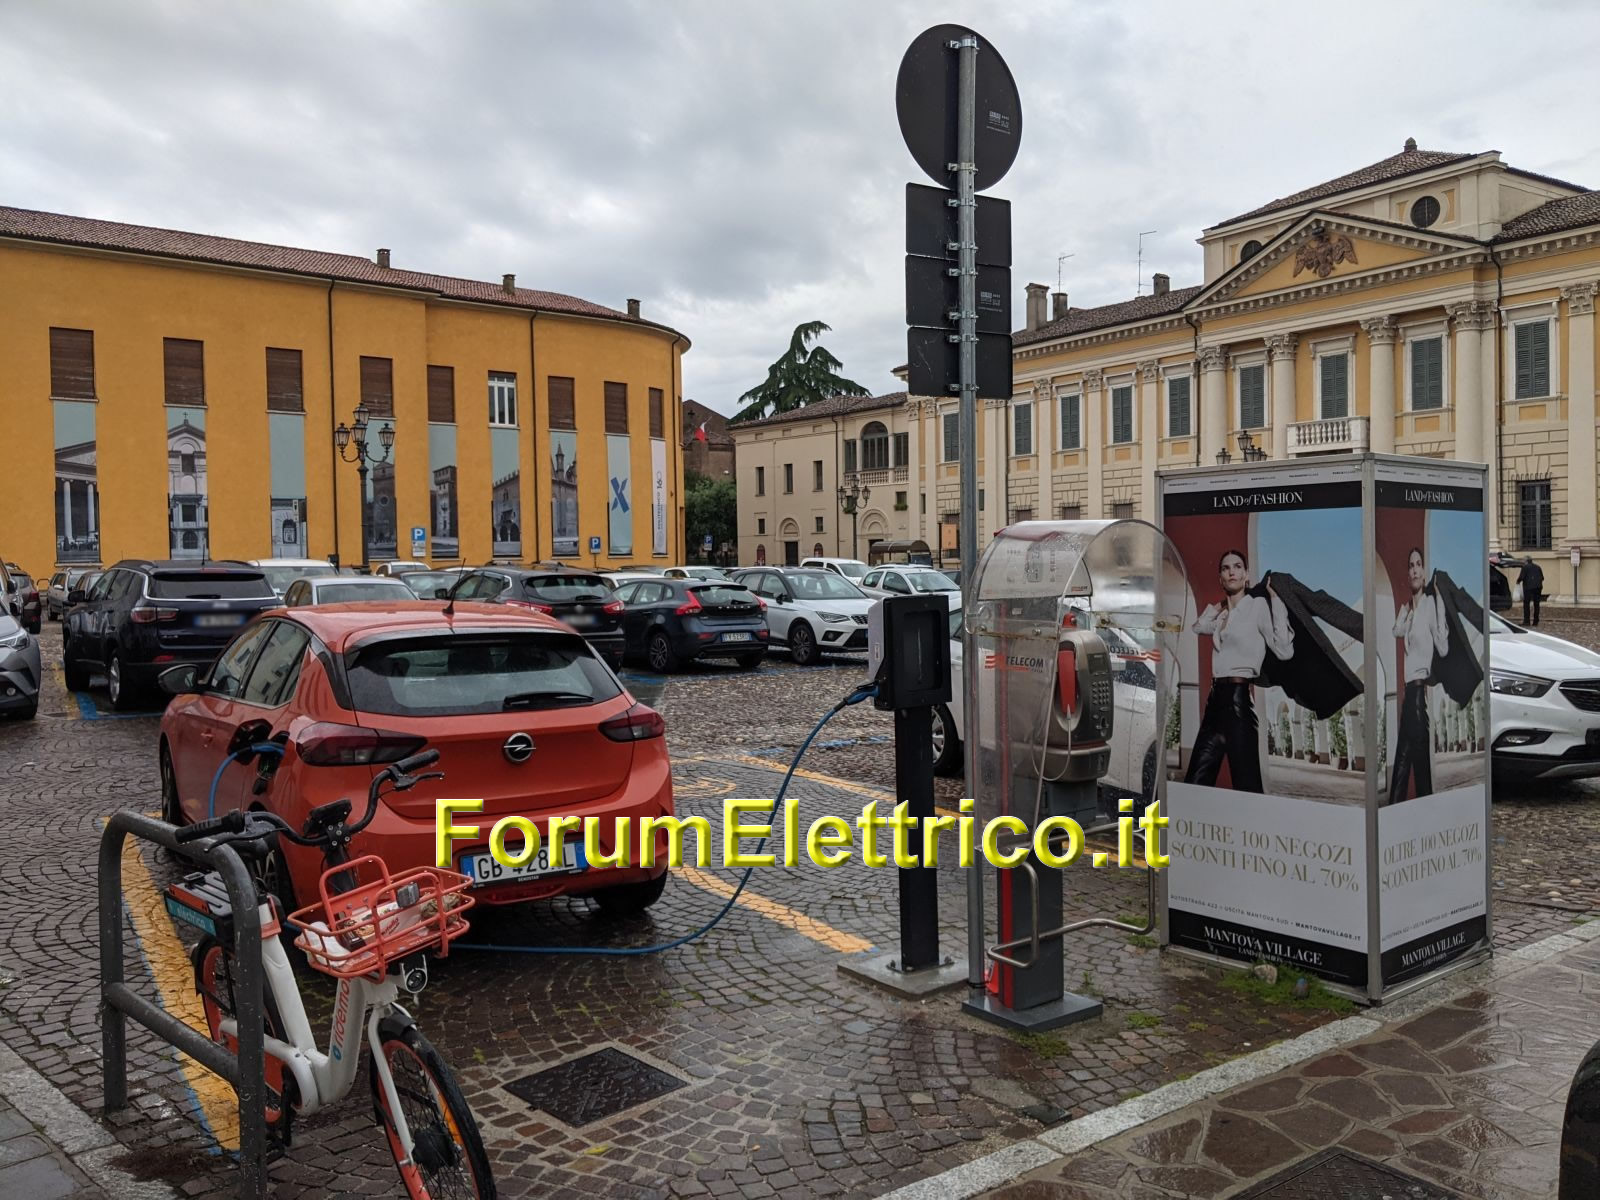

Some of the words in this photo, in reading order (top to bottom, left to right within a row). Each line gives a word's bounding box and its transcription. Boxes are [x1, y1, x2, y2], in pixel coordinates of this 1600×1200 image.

[1214, 495, 1244, 508] LAND
[1244, 494, 1253, 506] of
[1253, 491, 1303, 506] FASHION
[1405, 489, 1423, 502] LAND
[1427, 491, 1454, 503] FASHION
[414, 528, 424, 540] P
[592, 537, 599, 549] P
[1006, 656, 1044, 668] TELECOM
[1175, 818, 1234, 845] OLTRE
[1241, 830, 1270, 850] 100
[1275, 835, 1353, 866] NEGOZI
[1383, 838, 1417, 866] OLTRE
[1421, 833, 1437, 854] 100
[1438, 822, 1479, 849] NEGOZI
[1170, 840, 1236, 869] SCONTI
[1241, 852, 1287, 879] FINO
[1289, 862, 1316, 884] AL
[1320, 867, 1360, 893] 70%
[1381, 863, 1419, 891] SCONTI
[1420, 854, 1446, 879] FINO
[1461, 846, 1482, 866] 70%
[1224, 906, 1245, 915] USCITA
[1246, 910, 1275, 922] MANTOVA
[1276, 917, 1289, 926] SUD
[1295, 922, 1361, 942] MANTOVAVILLAGE.IT
[1203, 925, 1264, 951] MANTOVA
[1265, 939, 1323, 967] VILLAGE
[1401, 942, 1436, 967] MANTOVA
[1436, 931, 1466, 953] VILLAGE
